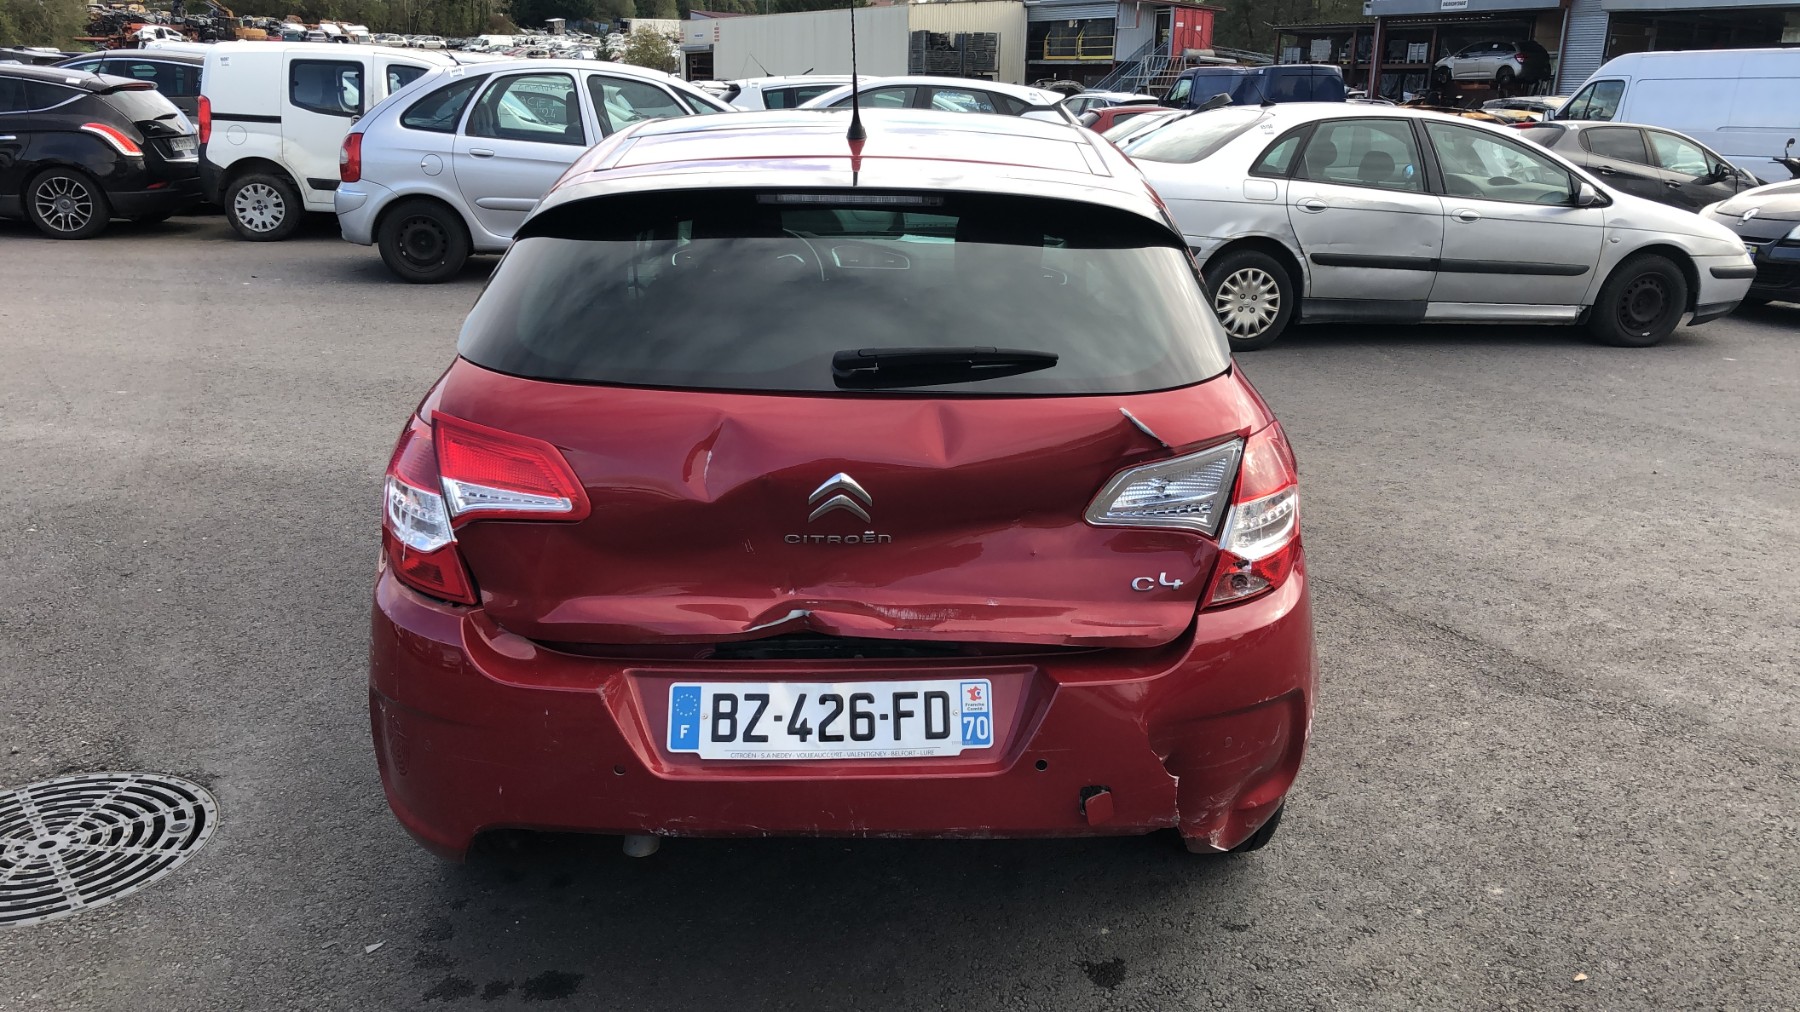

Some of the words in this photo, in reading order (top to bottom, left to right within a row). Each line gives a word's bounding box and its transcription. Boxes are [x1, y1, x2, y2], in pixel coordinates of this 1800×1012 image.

[784, 530, 892, 544] CITROËN
[1131, 572, 1184, 591] C4
[711, 691, 951, 743] BZ-426-FD
[679, 724, 690, 739] F
[963, 716, 988, 741] 70
[890, 749, 916, 757] BELFORT
